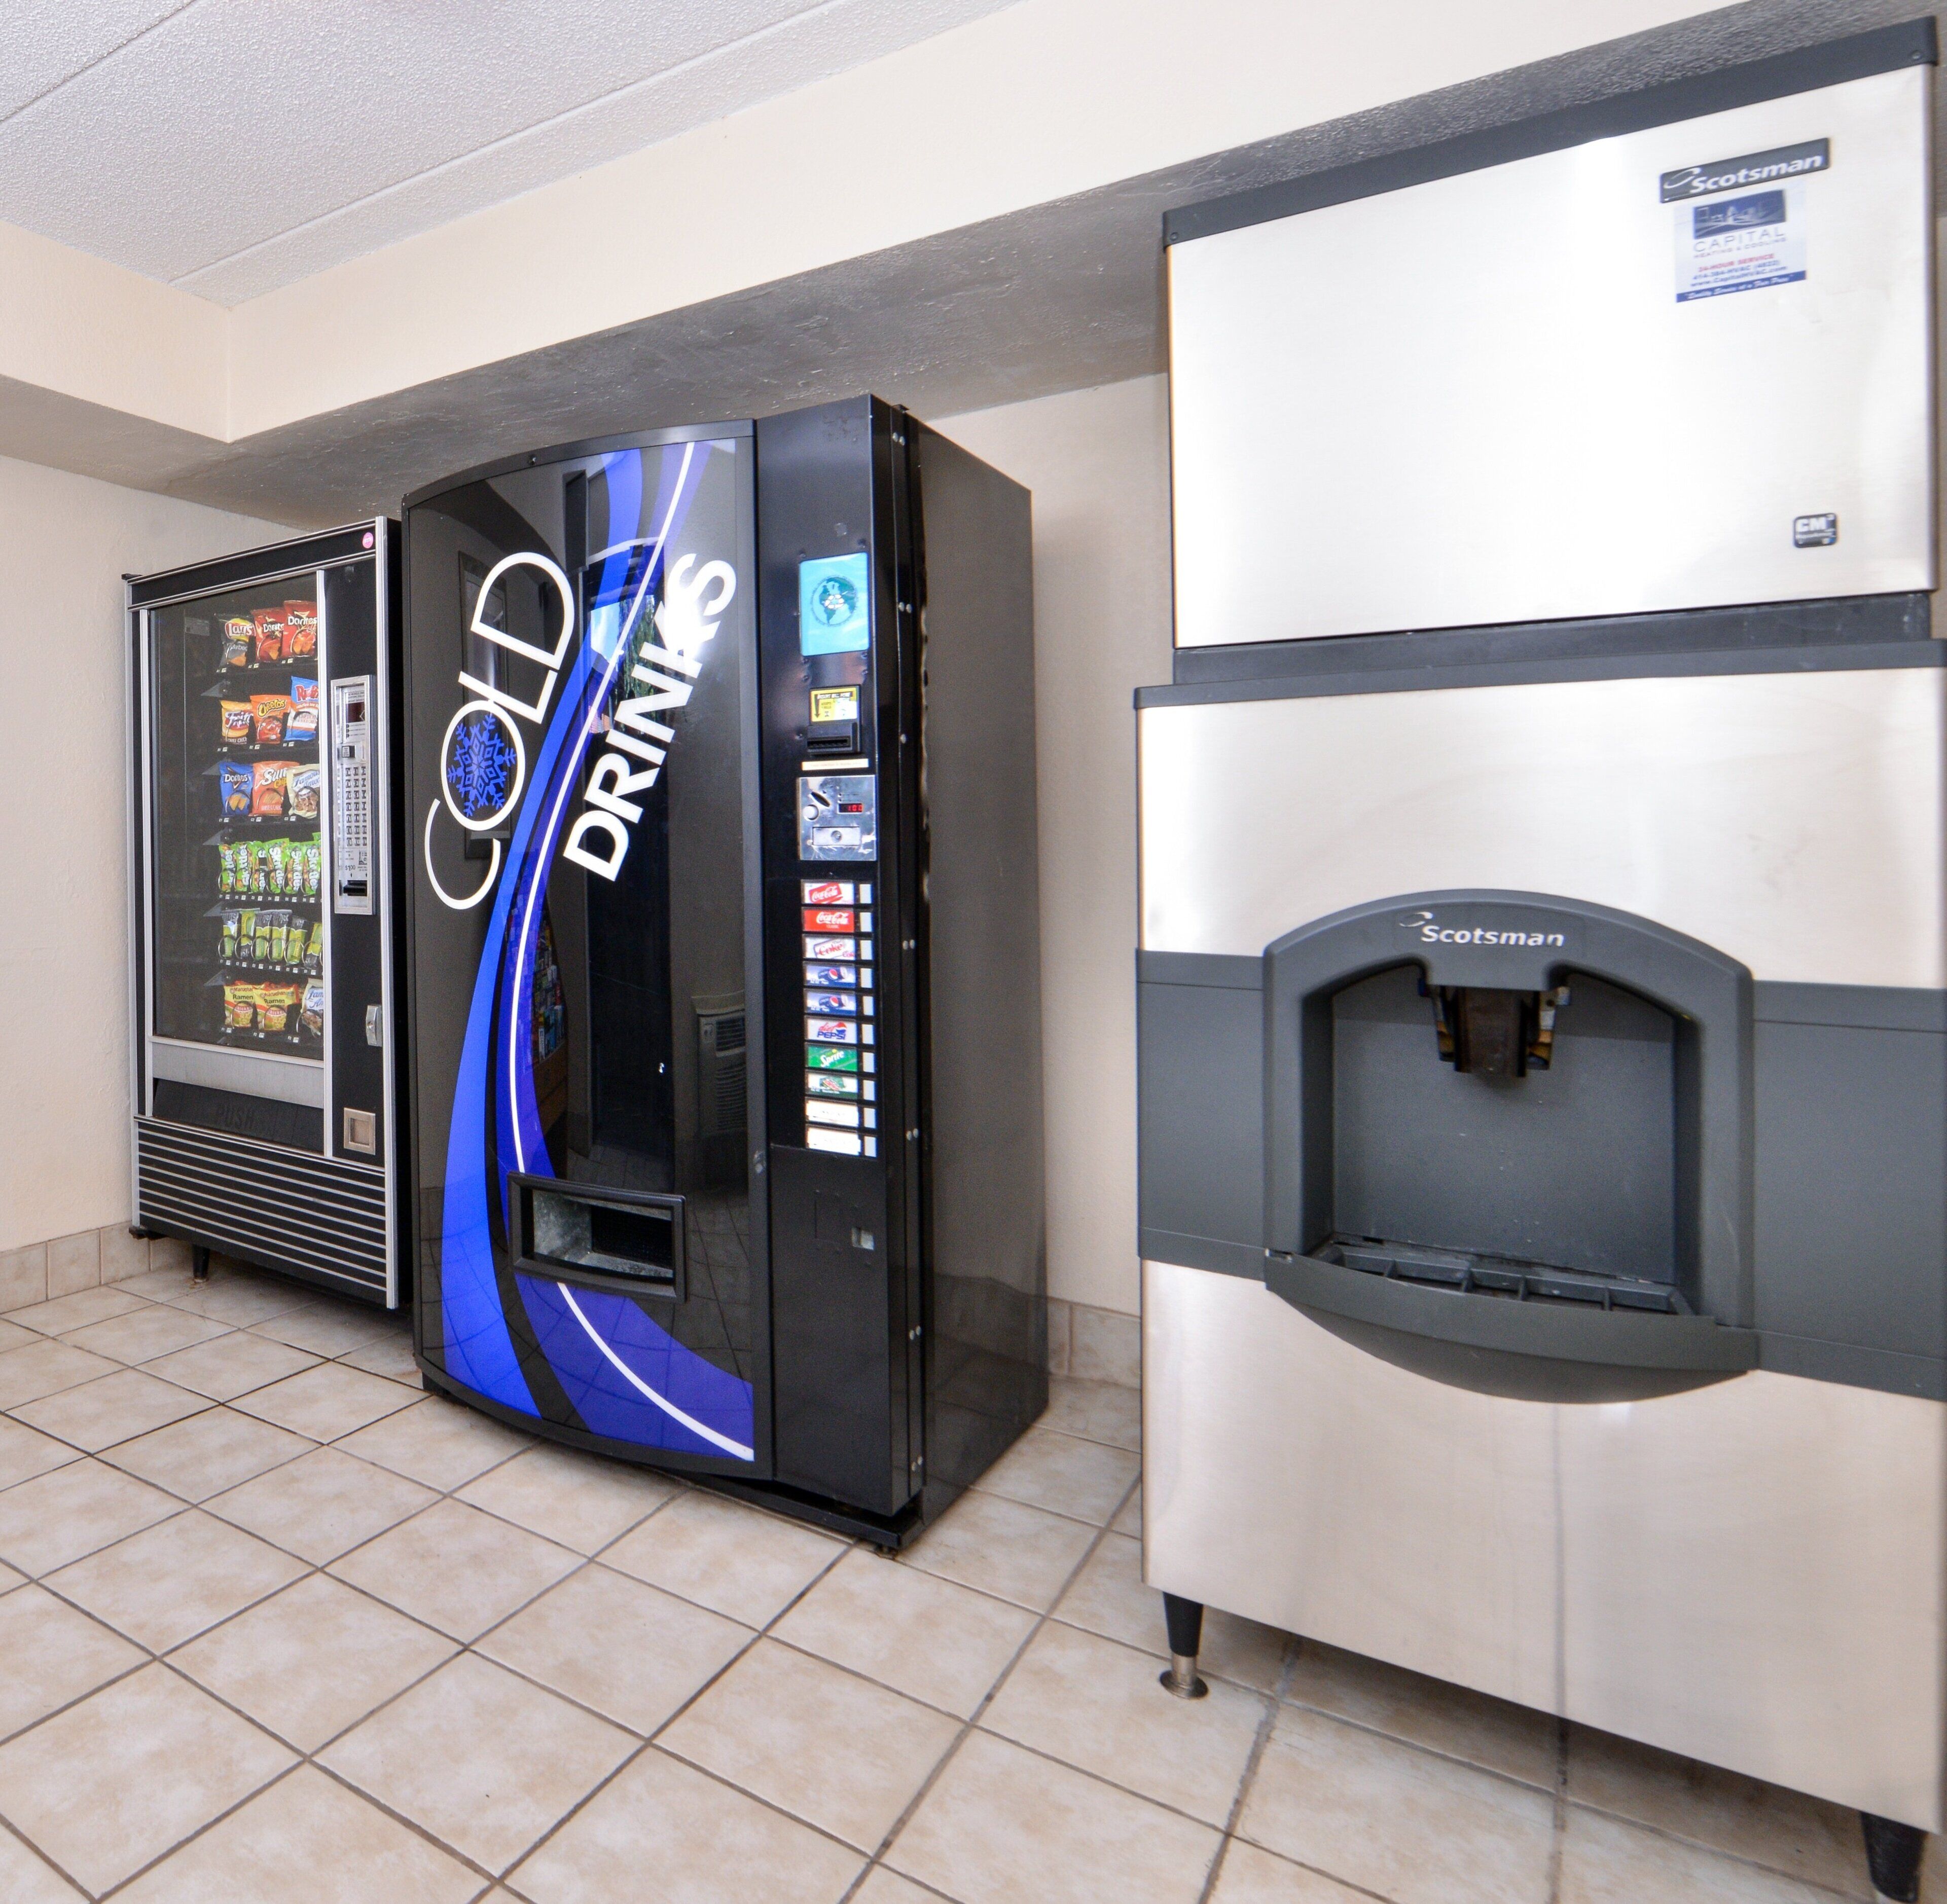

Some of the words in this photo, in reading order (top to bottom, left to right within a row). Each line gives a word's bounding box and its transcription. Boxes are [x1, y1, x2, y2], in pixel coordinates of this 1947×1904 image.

[1689, 154, 1823, 193] Scotsman
[1693, 227, 1785, 252] CAPITAL
[1738, 253, 1774, 265] SERVICE
[257, 699, 286, 717] Cheetos
[562, 553, 737, 882] DRINKS
[424, 552, 575, 910] COLD
[224, 774, 248, 783] Doritos
[1420, 925, 1565, 947] Scotsman
[817, 1031, 846, 1040] PEPSI
[820, 1050, 845, 1068] Sprite
